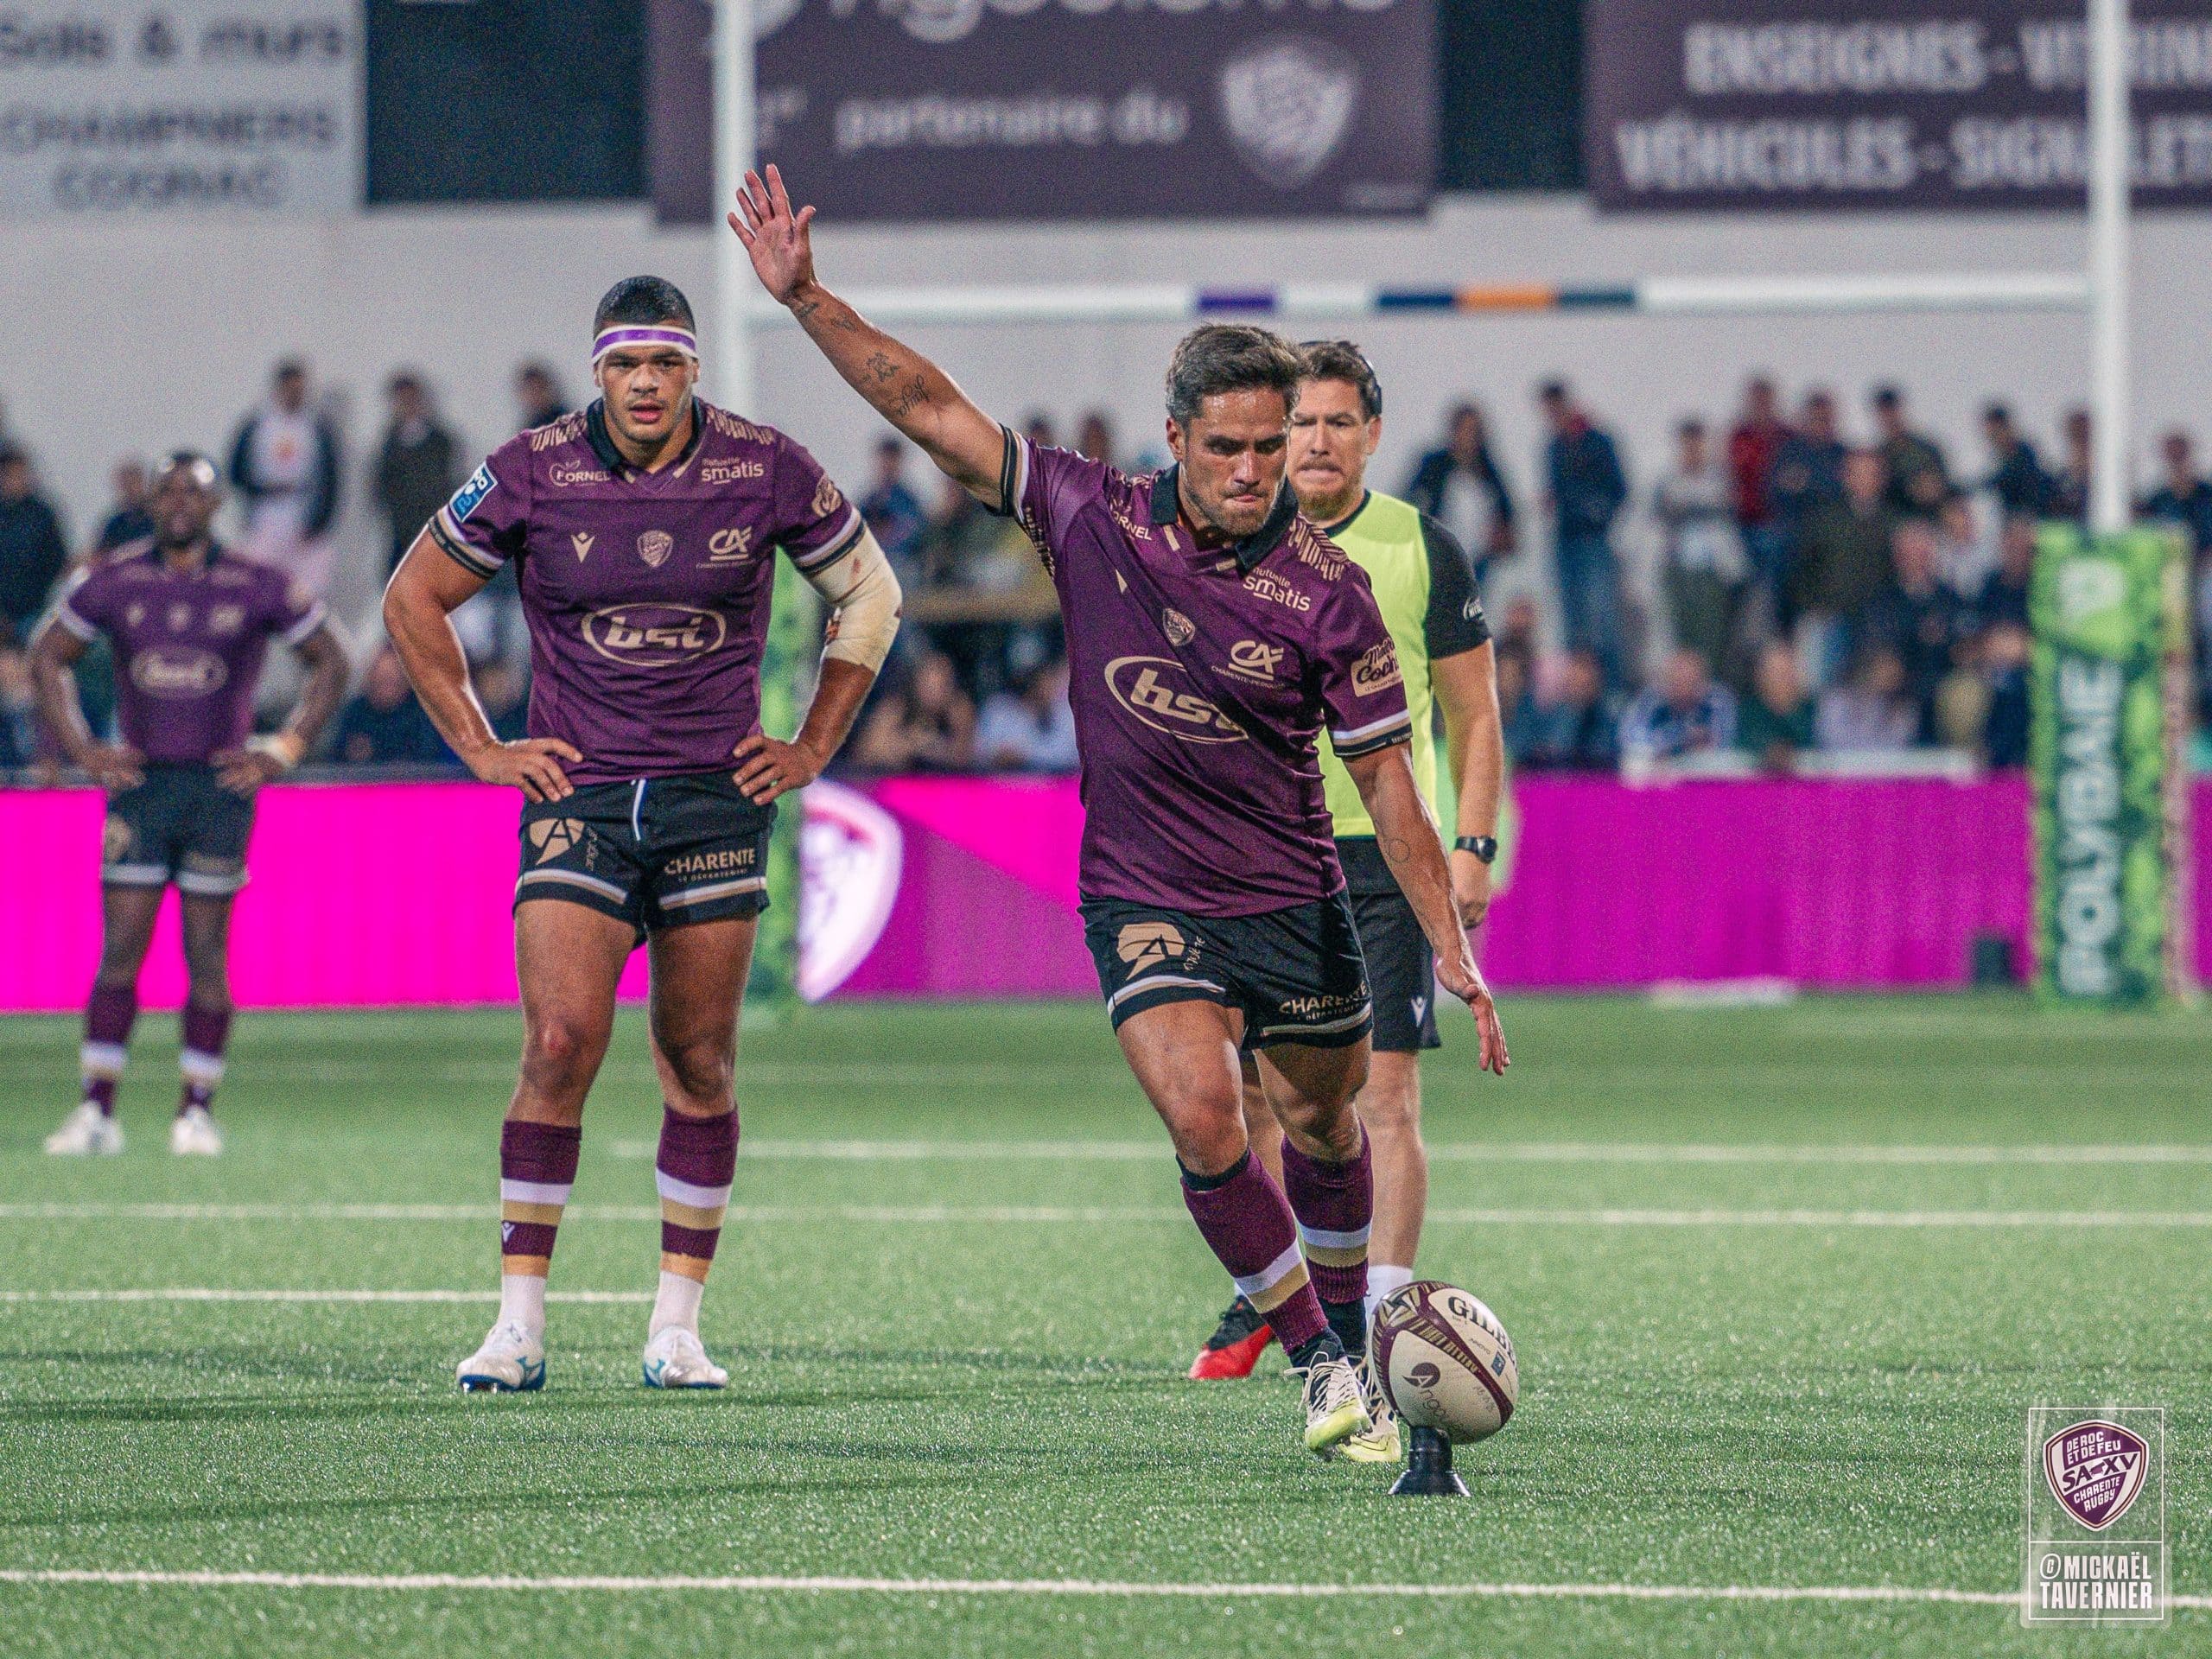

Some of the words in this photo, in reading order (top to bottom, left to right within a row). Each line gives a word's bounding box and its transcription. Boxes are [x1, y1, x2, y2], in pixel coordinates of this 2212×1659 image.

[1683, 23, 1985, 93] ENSEIGNES
[836, 97, 1103, 153] partenaire
[1117, 87, 1189, 145] du
[1613, 108, 1915, 189] VÉHICULES
[701, 461, 765, 482] smatis
[1243, 575, 1312, 612] smatis
[663, 848, 756, 875] CHARENTE
